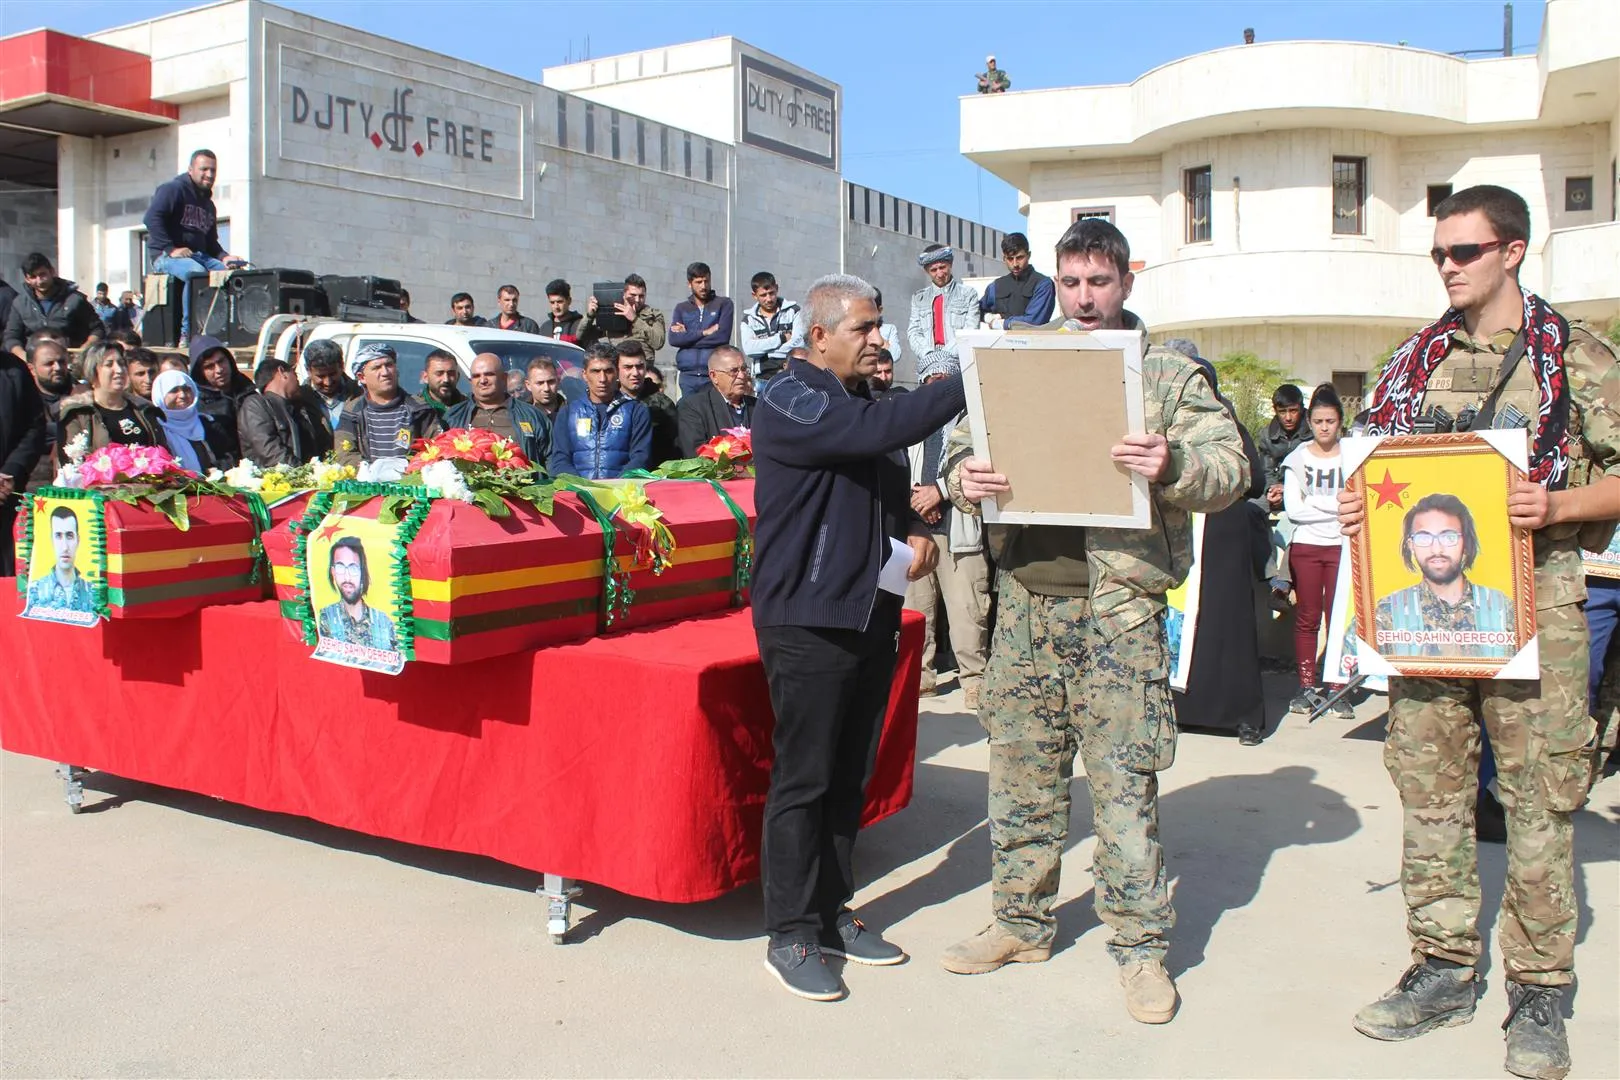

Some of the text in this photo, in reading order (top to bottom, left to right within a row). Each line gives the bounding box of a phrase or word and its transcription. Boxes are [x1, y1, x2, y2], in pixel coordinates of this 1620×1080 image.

[748, 82, 784, 118] DUTY
[804, 103, 831, 135] FREE
[426, 117, 493, 162] FREE
